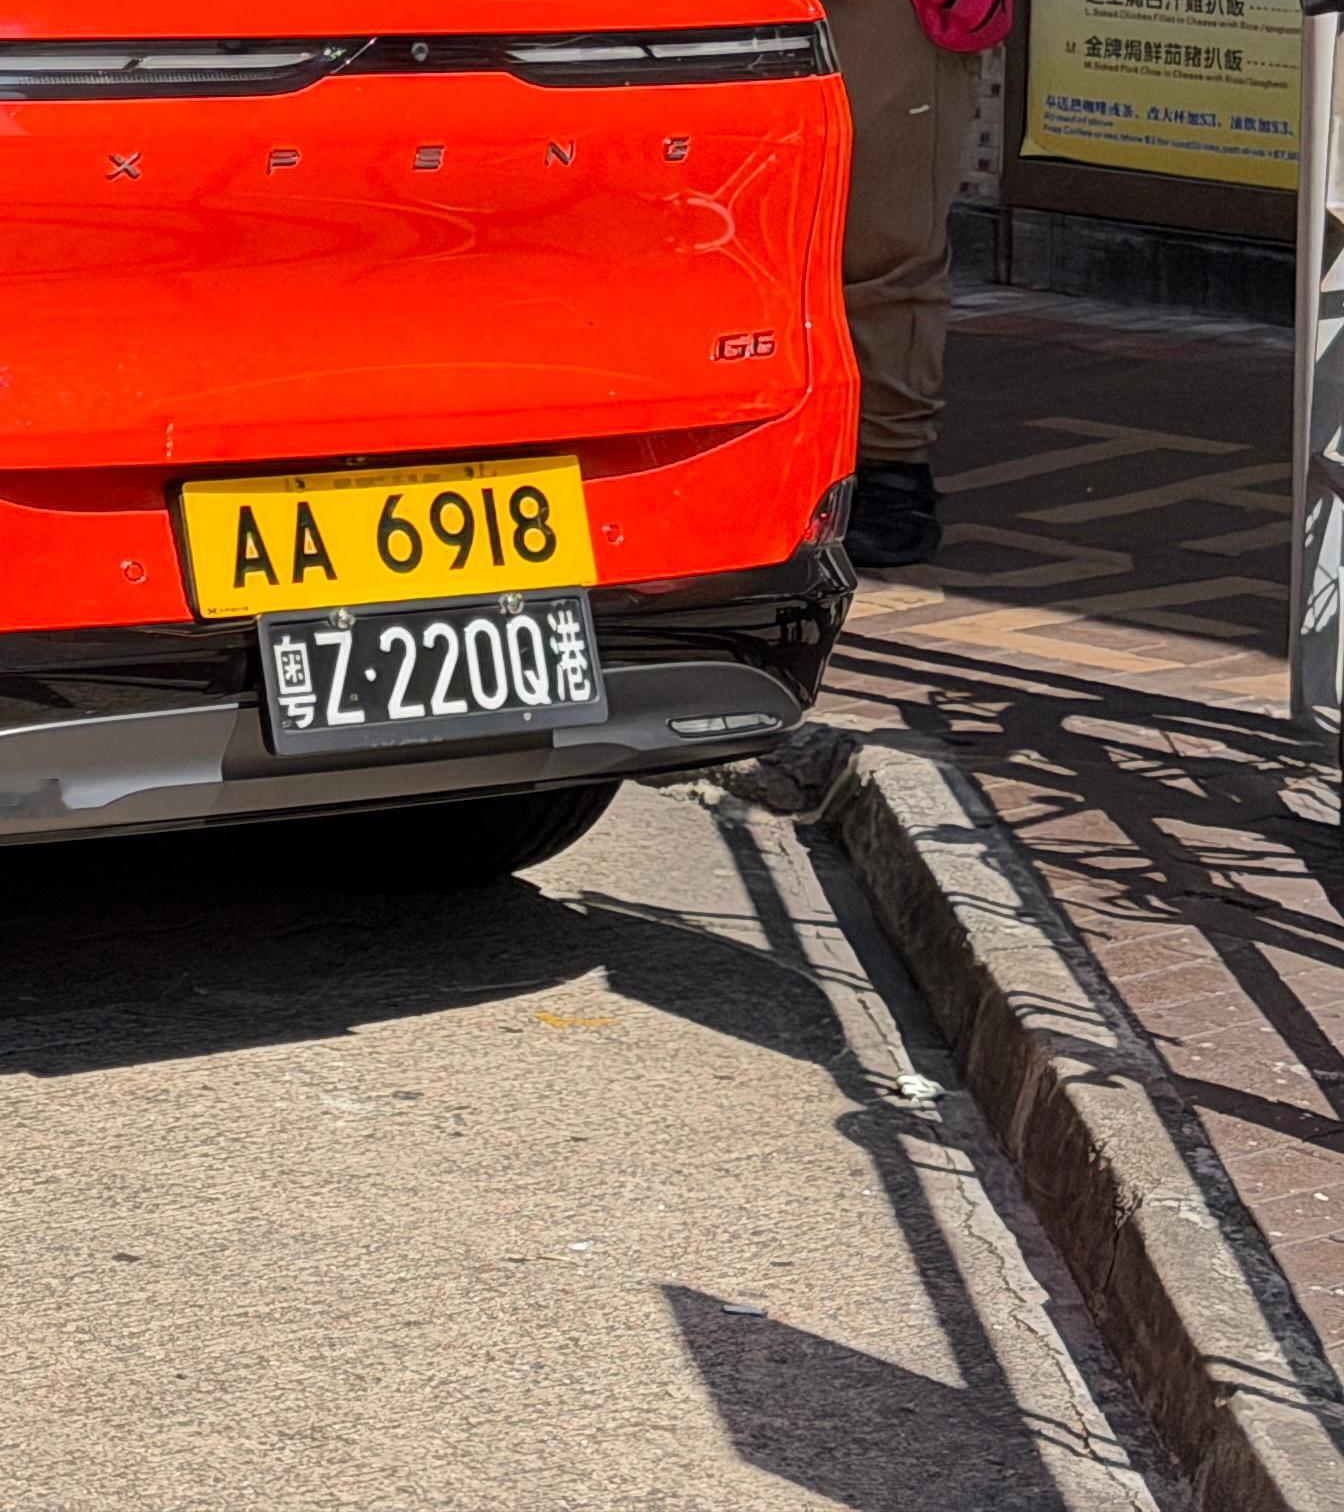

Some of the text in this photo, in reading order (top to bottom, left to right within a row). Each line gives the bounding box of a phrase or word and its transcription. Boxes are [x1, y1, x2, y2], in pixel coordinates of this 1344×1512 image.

[107, 136, 690, 180] XPENG
[714, 329, 777, 361] G6
[233, 485, 558, 588] AA 6918
